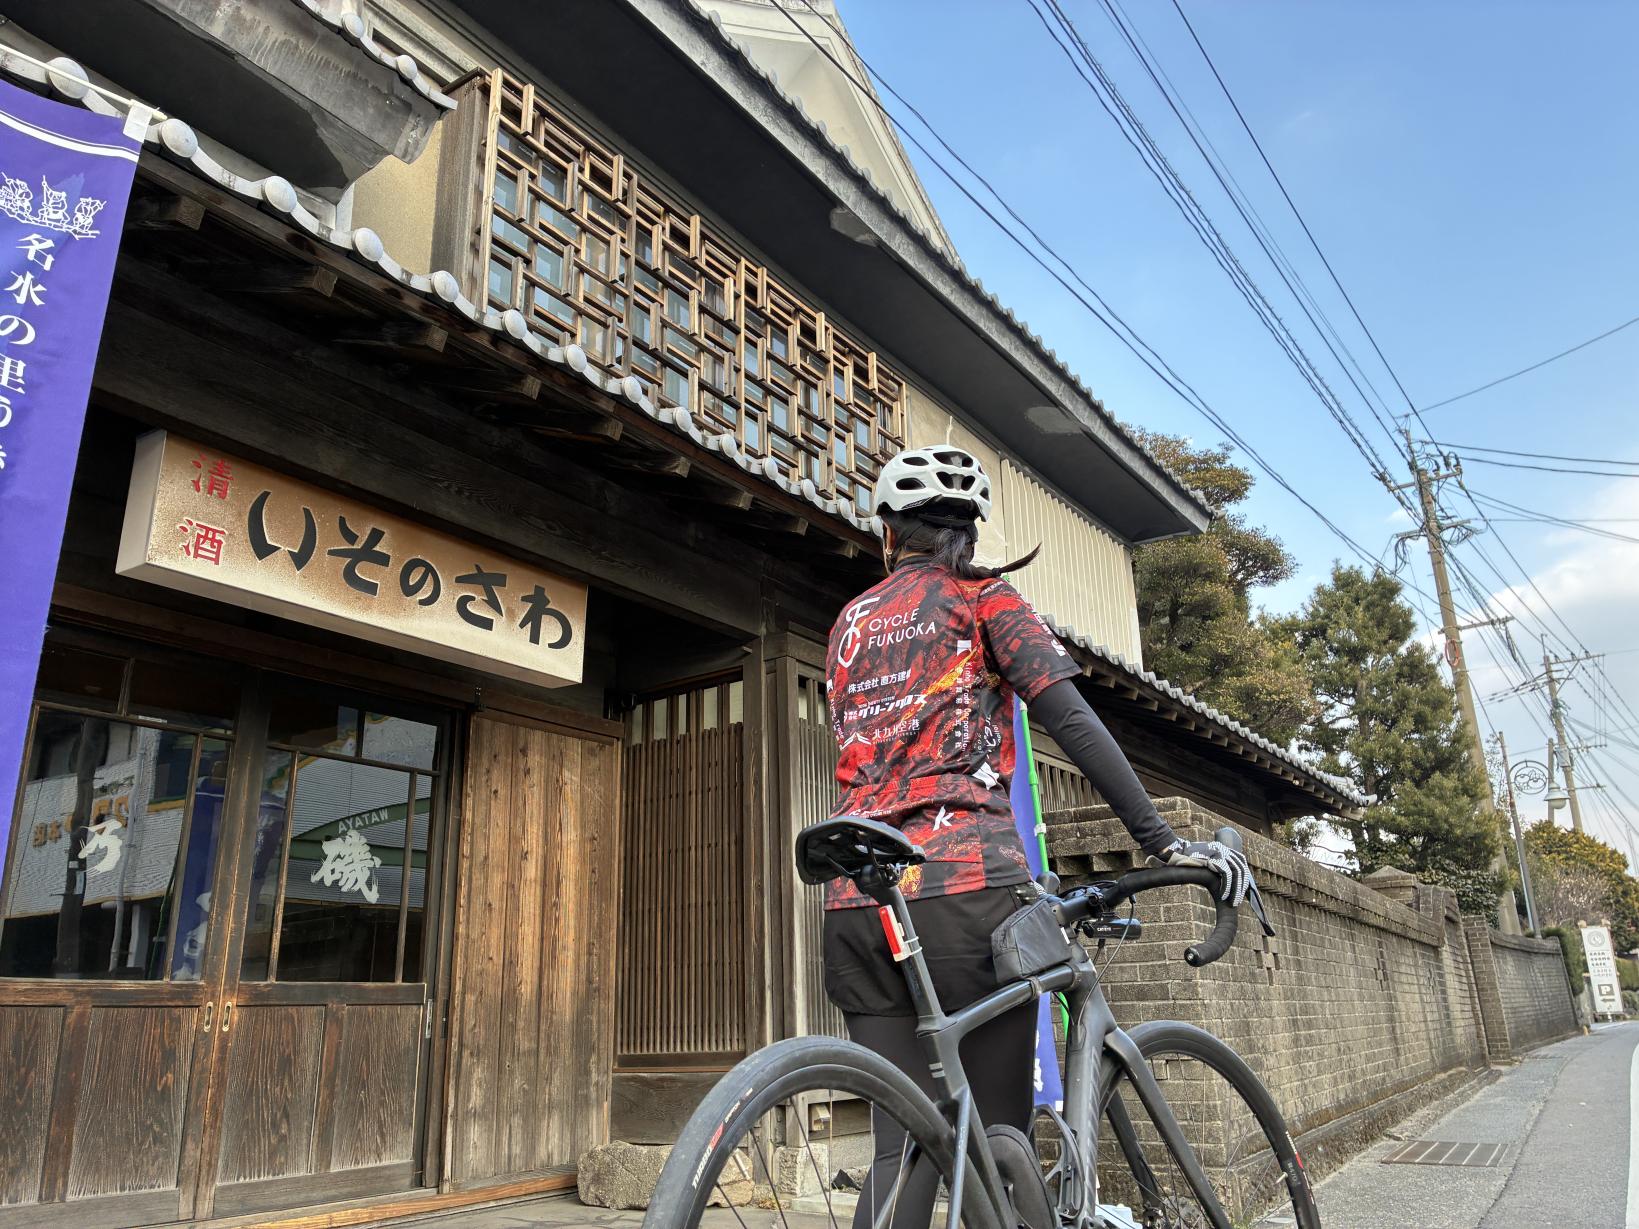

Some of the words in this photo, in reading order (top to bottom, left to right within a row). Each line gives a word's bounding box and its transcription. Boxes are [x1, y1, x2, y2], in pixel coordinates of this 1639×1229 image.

[178, 454, 235, 567] 清酒
[246, 490, 574, 650] いそのさわ
[868, 607, 919, 632] CYCLE
[867, 621, 936, 649] FUKUOKA
[848, 677, 879, 694] 株式会社
[872, 717, 920, 738] 北九州空港
